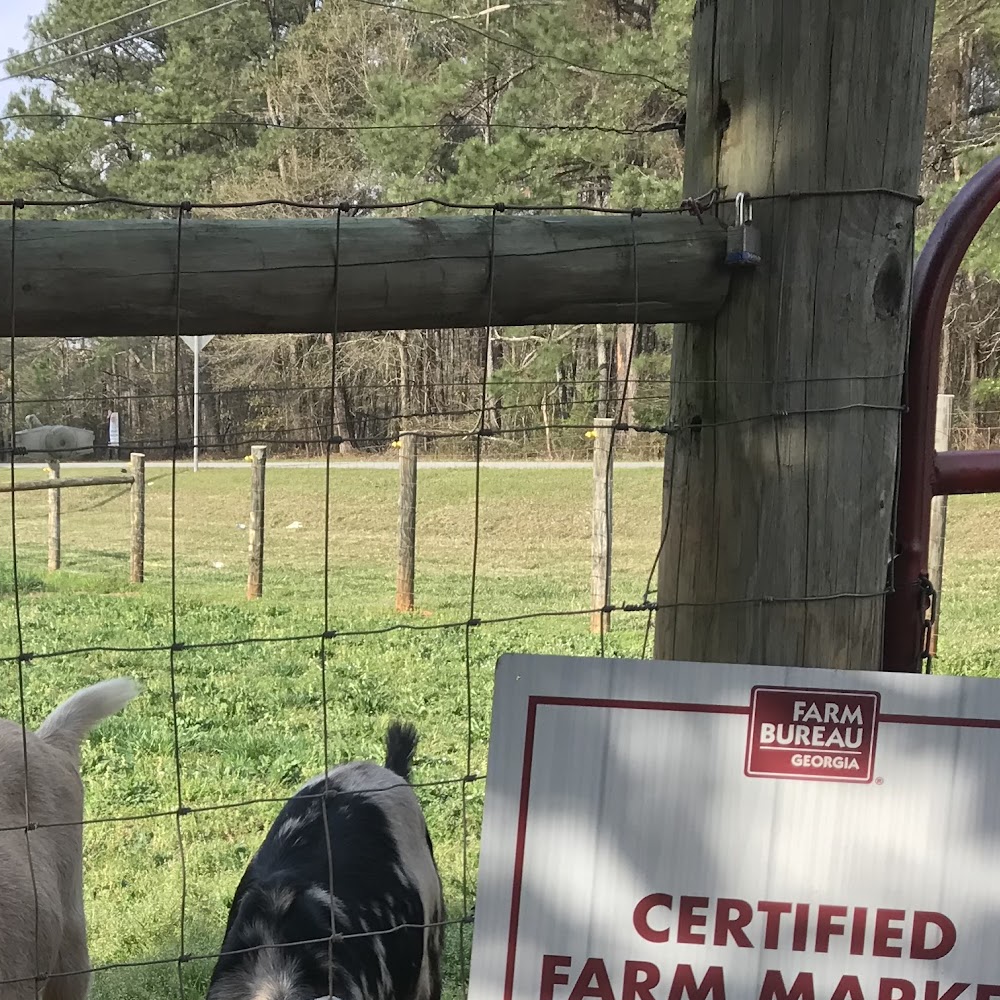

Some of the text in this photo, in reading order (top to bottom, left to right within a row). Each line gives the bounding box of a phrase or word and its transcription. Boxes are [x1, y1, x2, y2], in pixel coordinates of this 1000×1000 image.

[793, 701, 863, 725] FARM
[760, 723, 863, 748] BUREAU
[791, 754, 860, 770] GEORGIA
[633, 893, 957, 960] CERTIFIED
